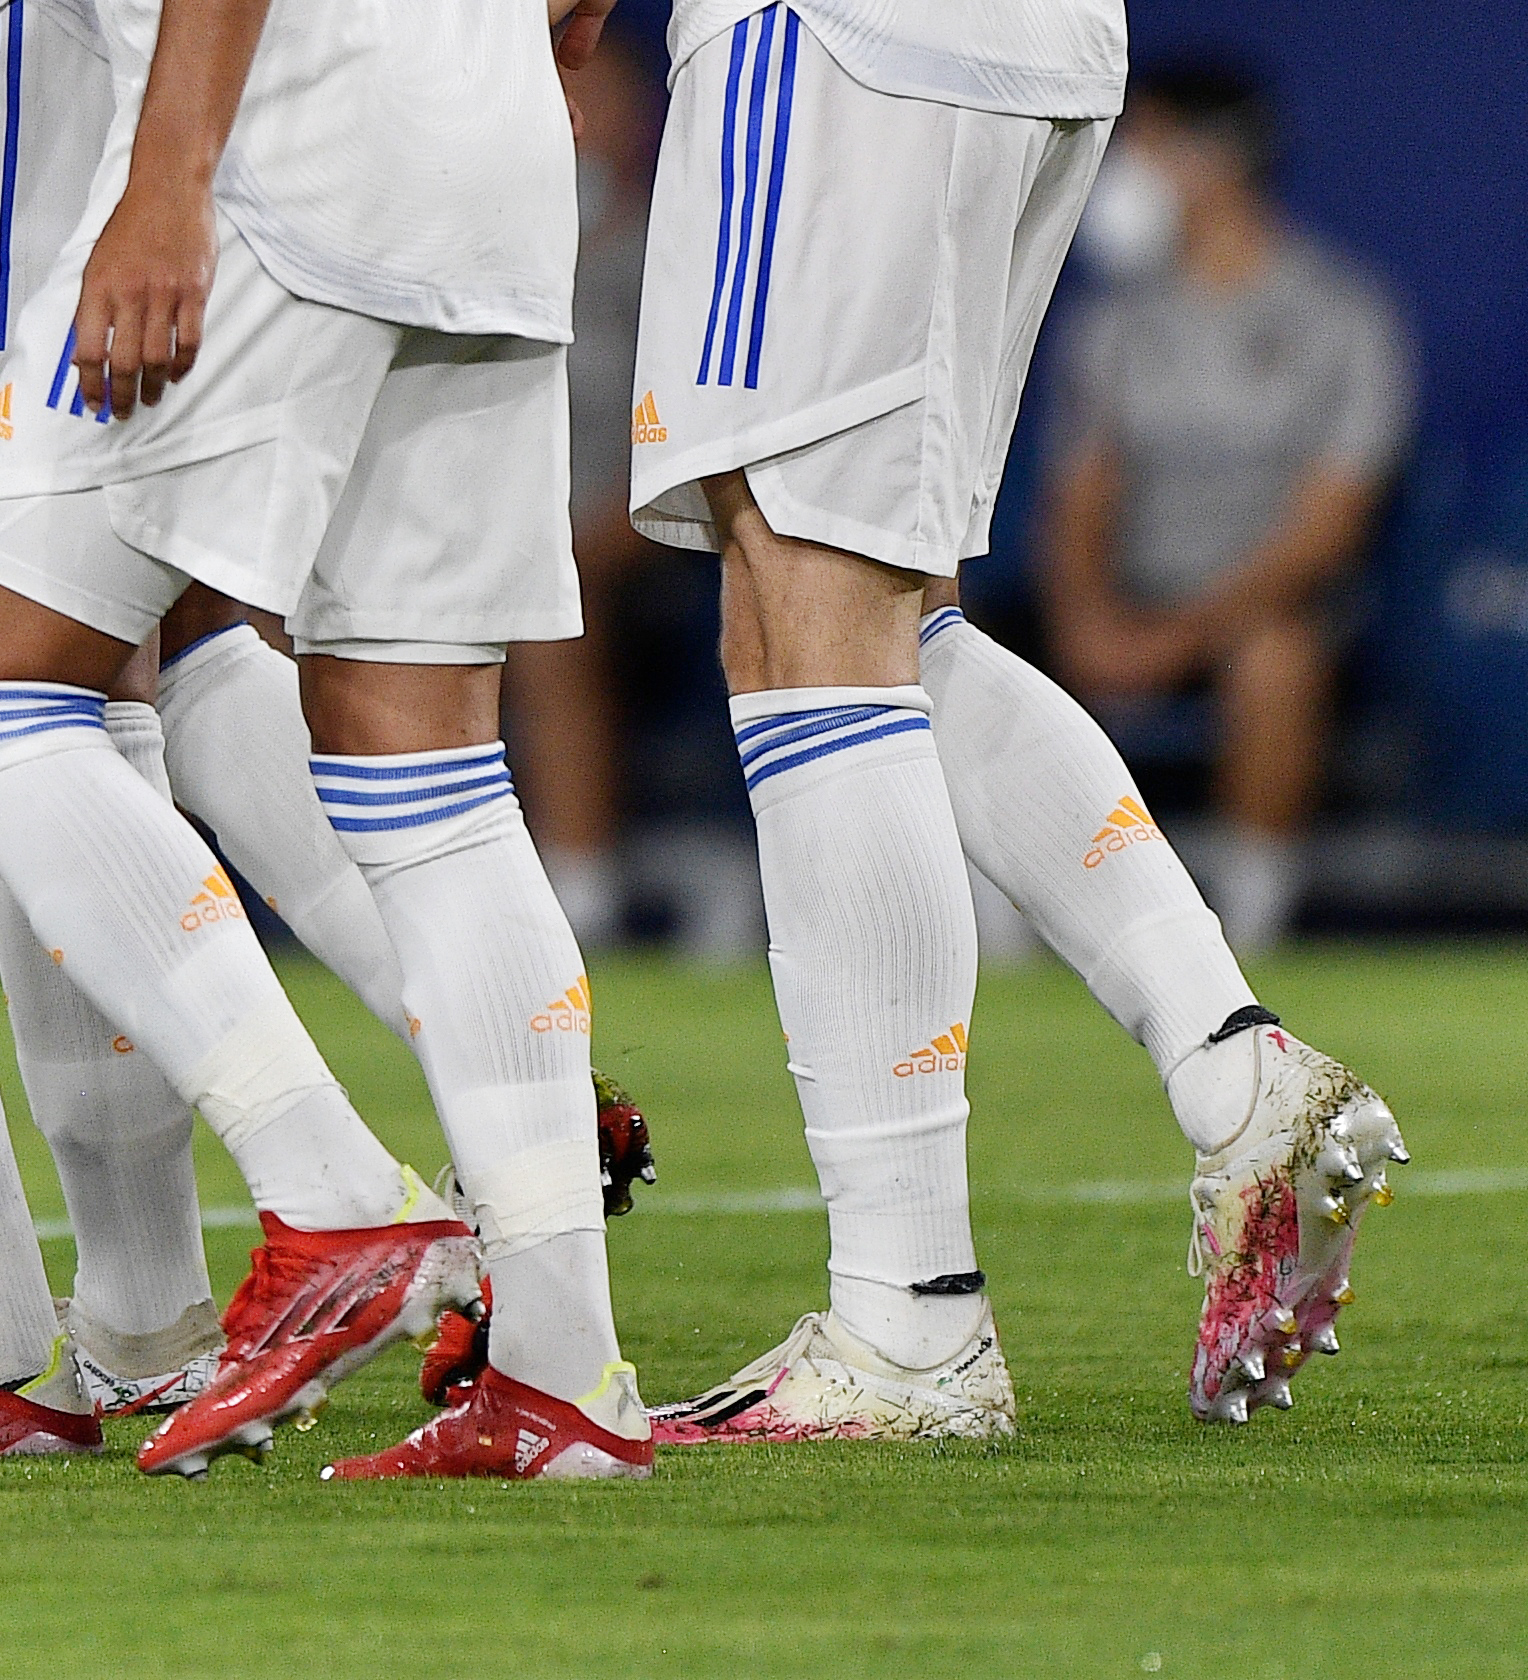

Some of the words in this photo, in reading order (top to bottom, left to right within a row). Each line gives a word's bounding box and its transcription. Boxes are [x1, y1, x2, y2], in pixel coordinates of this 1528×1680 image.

[1083, 828, 1164, 868] adid
[893, 1055, 966, 1078] adid
[516, 1437, 550, 1474] adidas
